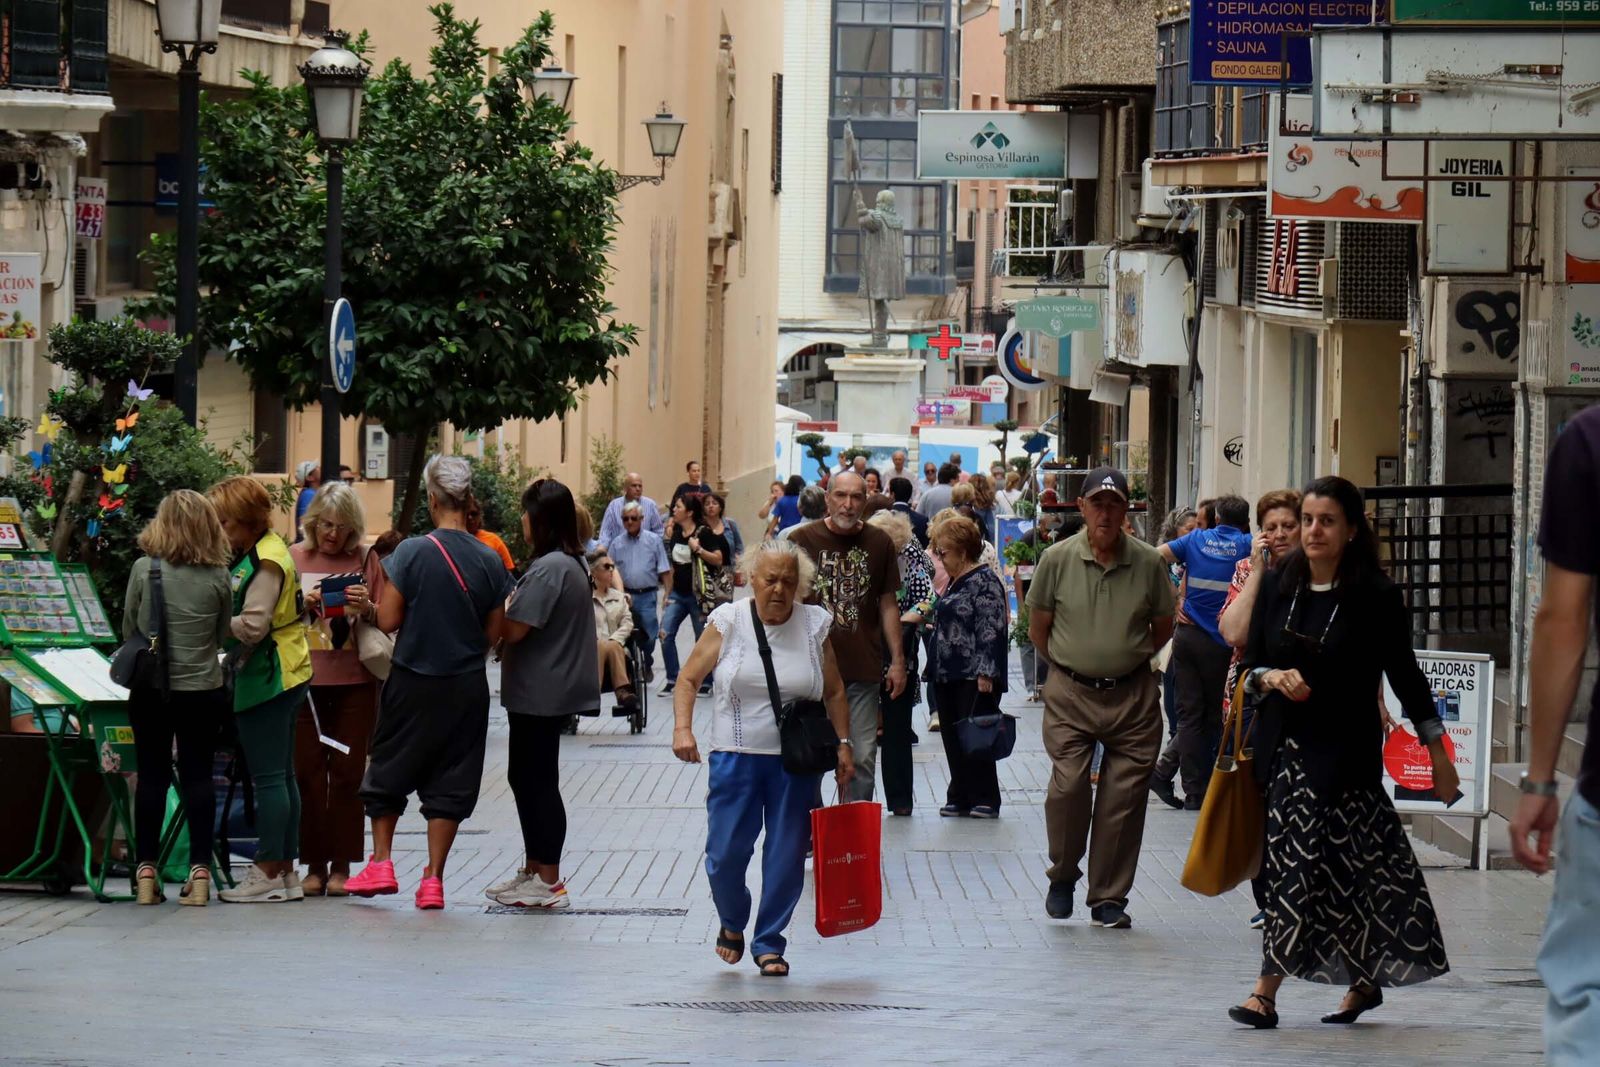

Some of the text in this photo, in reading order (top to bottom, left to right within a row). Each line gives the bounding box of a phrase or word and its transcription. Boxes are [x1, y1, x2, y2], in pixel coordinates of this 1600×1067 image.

[1217, 2, 1304, 15] DEPILACION
[1556, 1, 1580, 11] 959
[1217, 41, 1266, 54] SAUNA
[1214, 65, 1246, 75] FONDO
[997, 151, 1040, 163] Villarán
[1439, 158, 1504, 175] JOYERIA
[1452, 181, 1491, 197] GIL
[1427, 677, 1475, 691] IFICAS
